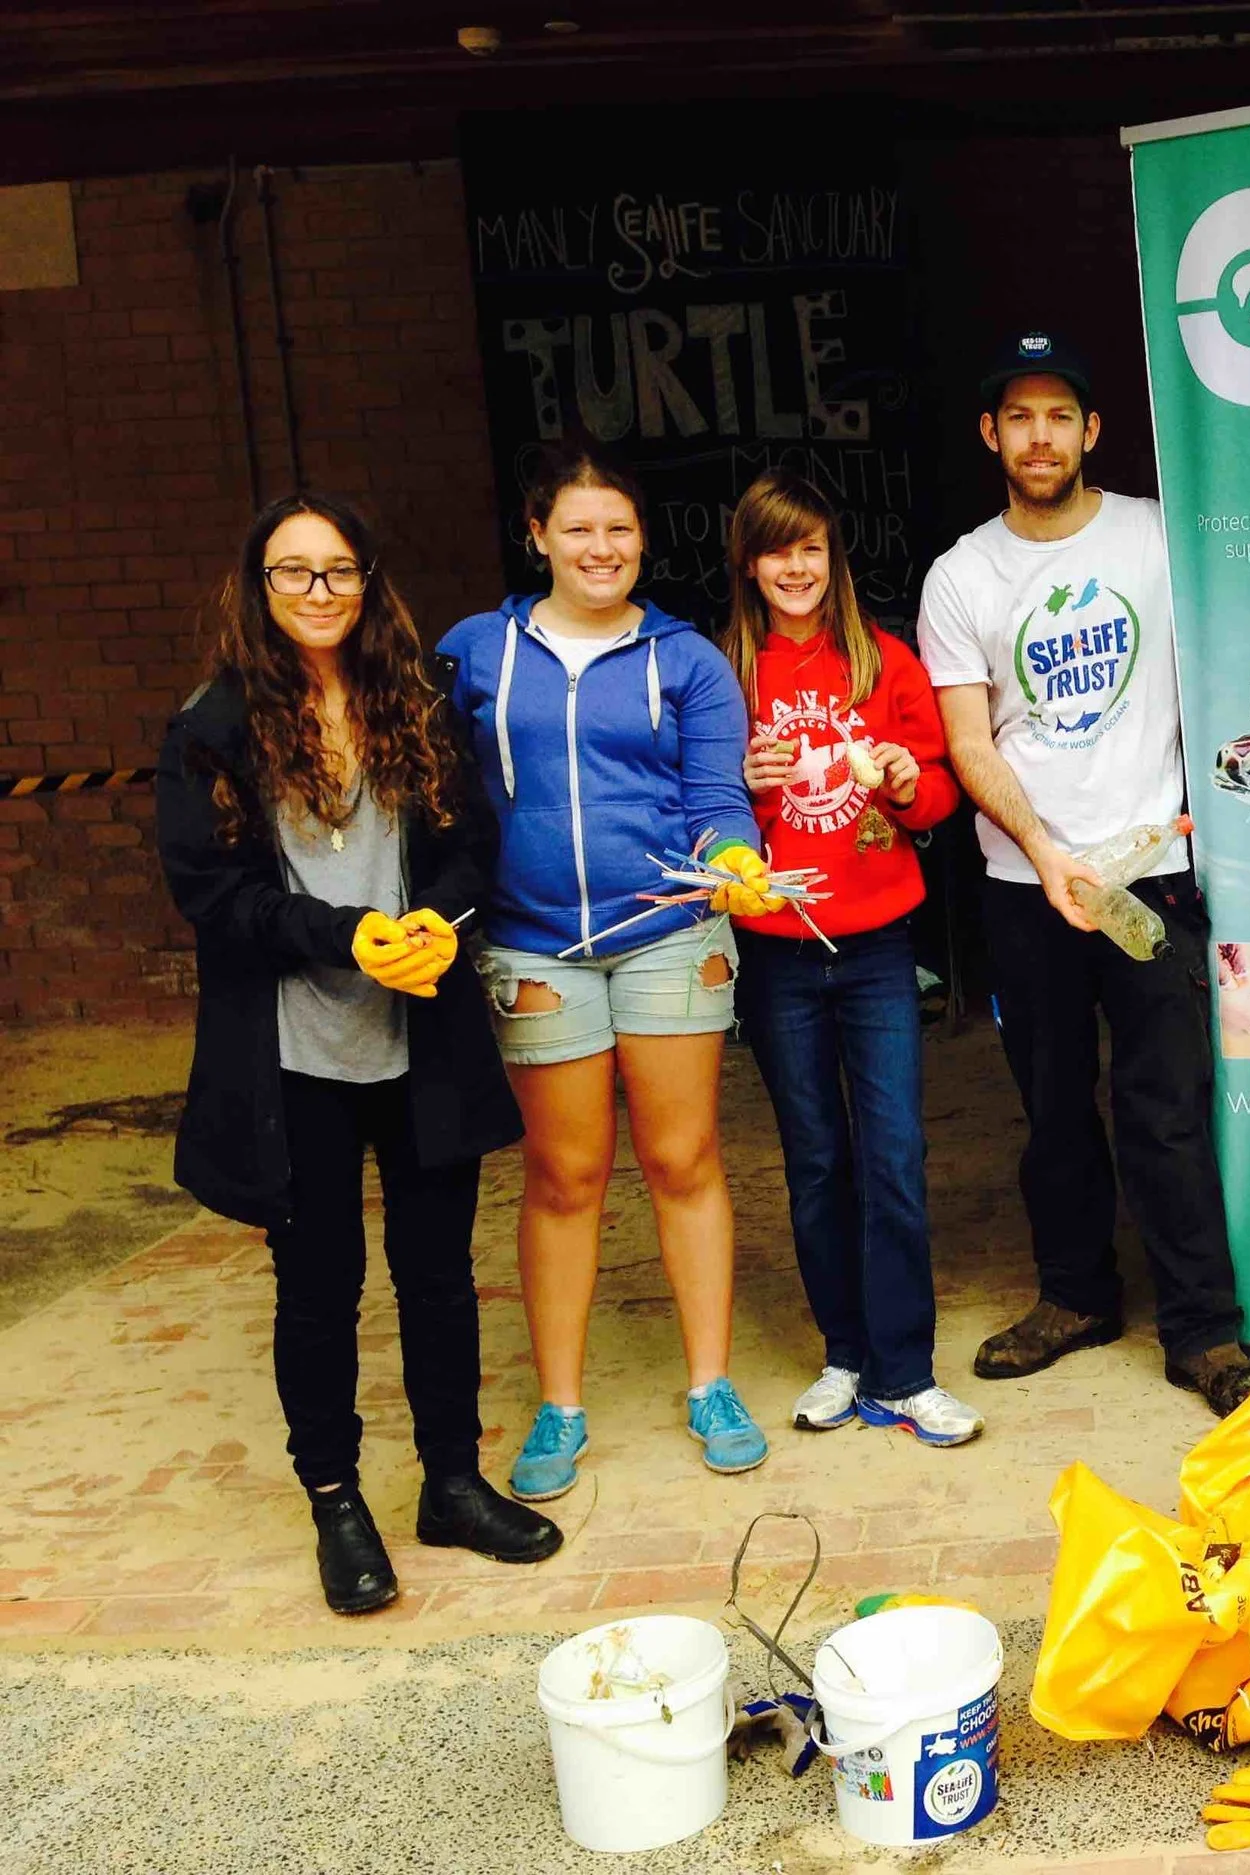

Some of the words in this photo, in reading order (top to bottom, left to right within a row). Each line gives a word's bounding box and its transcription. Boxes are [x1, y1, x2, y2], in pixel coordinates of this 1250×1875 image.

[477, 202, 600, 271] MANLY
[737, 185, 899, 263] SANCTUARY
[502, 288, 871, 443] TURTLE
[731, 446, 912, 510] MONTH
[1046, 658, 1119, 701] TRUST
[781, 783, 870, 834] USTRALIA
[960, 1703, 981, 1721] KEEP
[942, 1787, 970, 1806] TRUST
